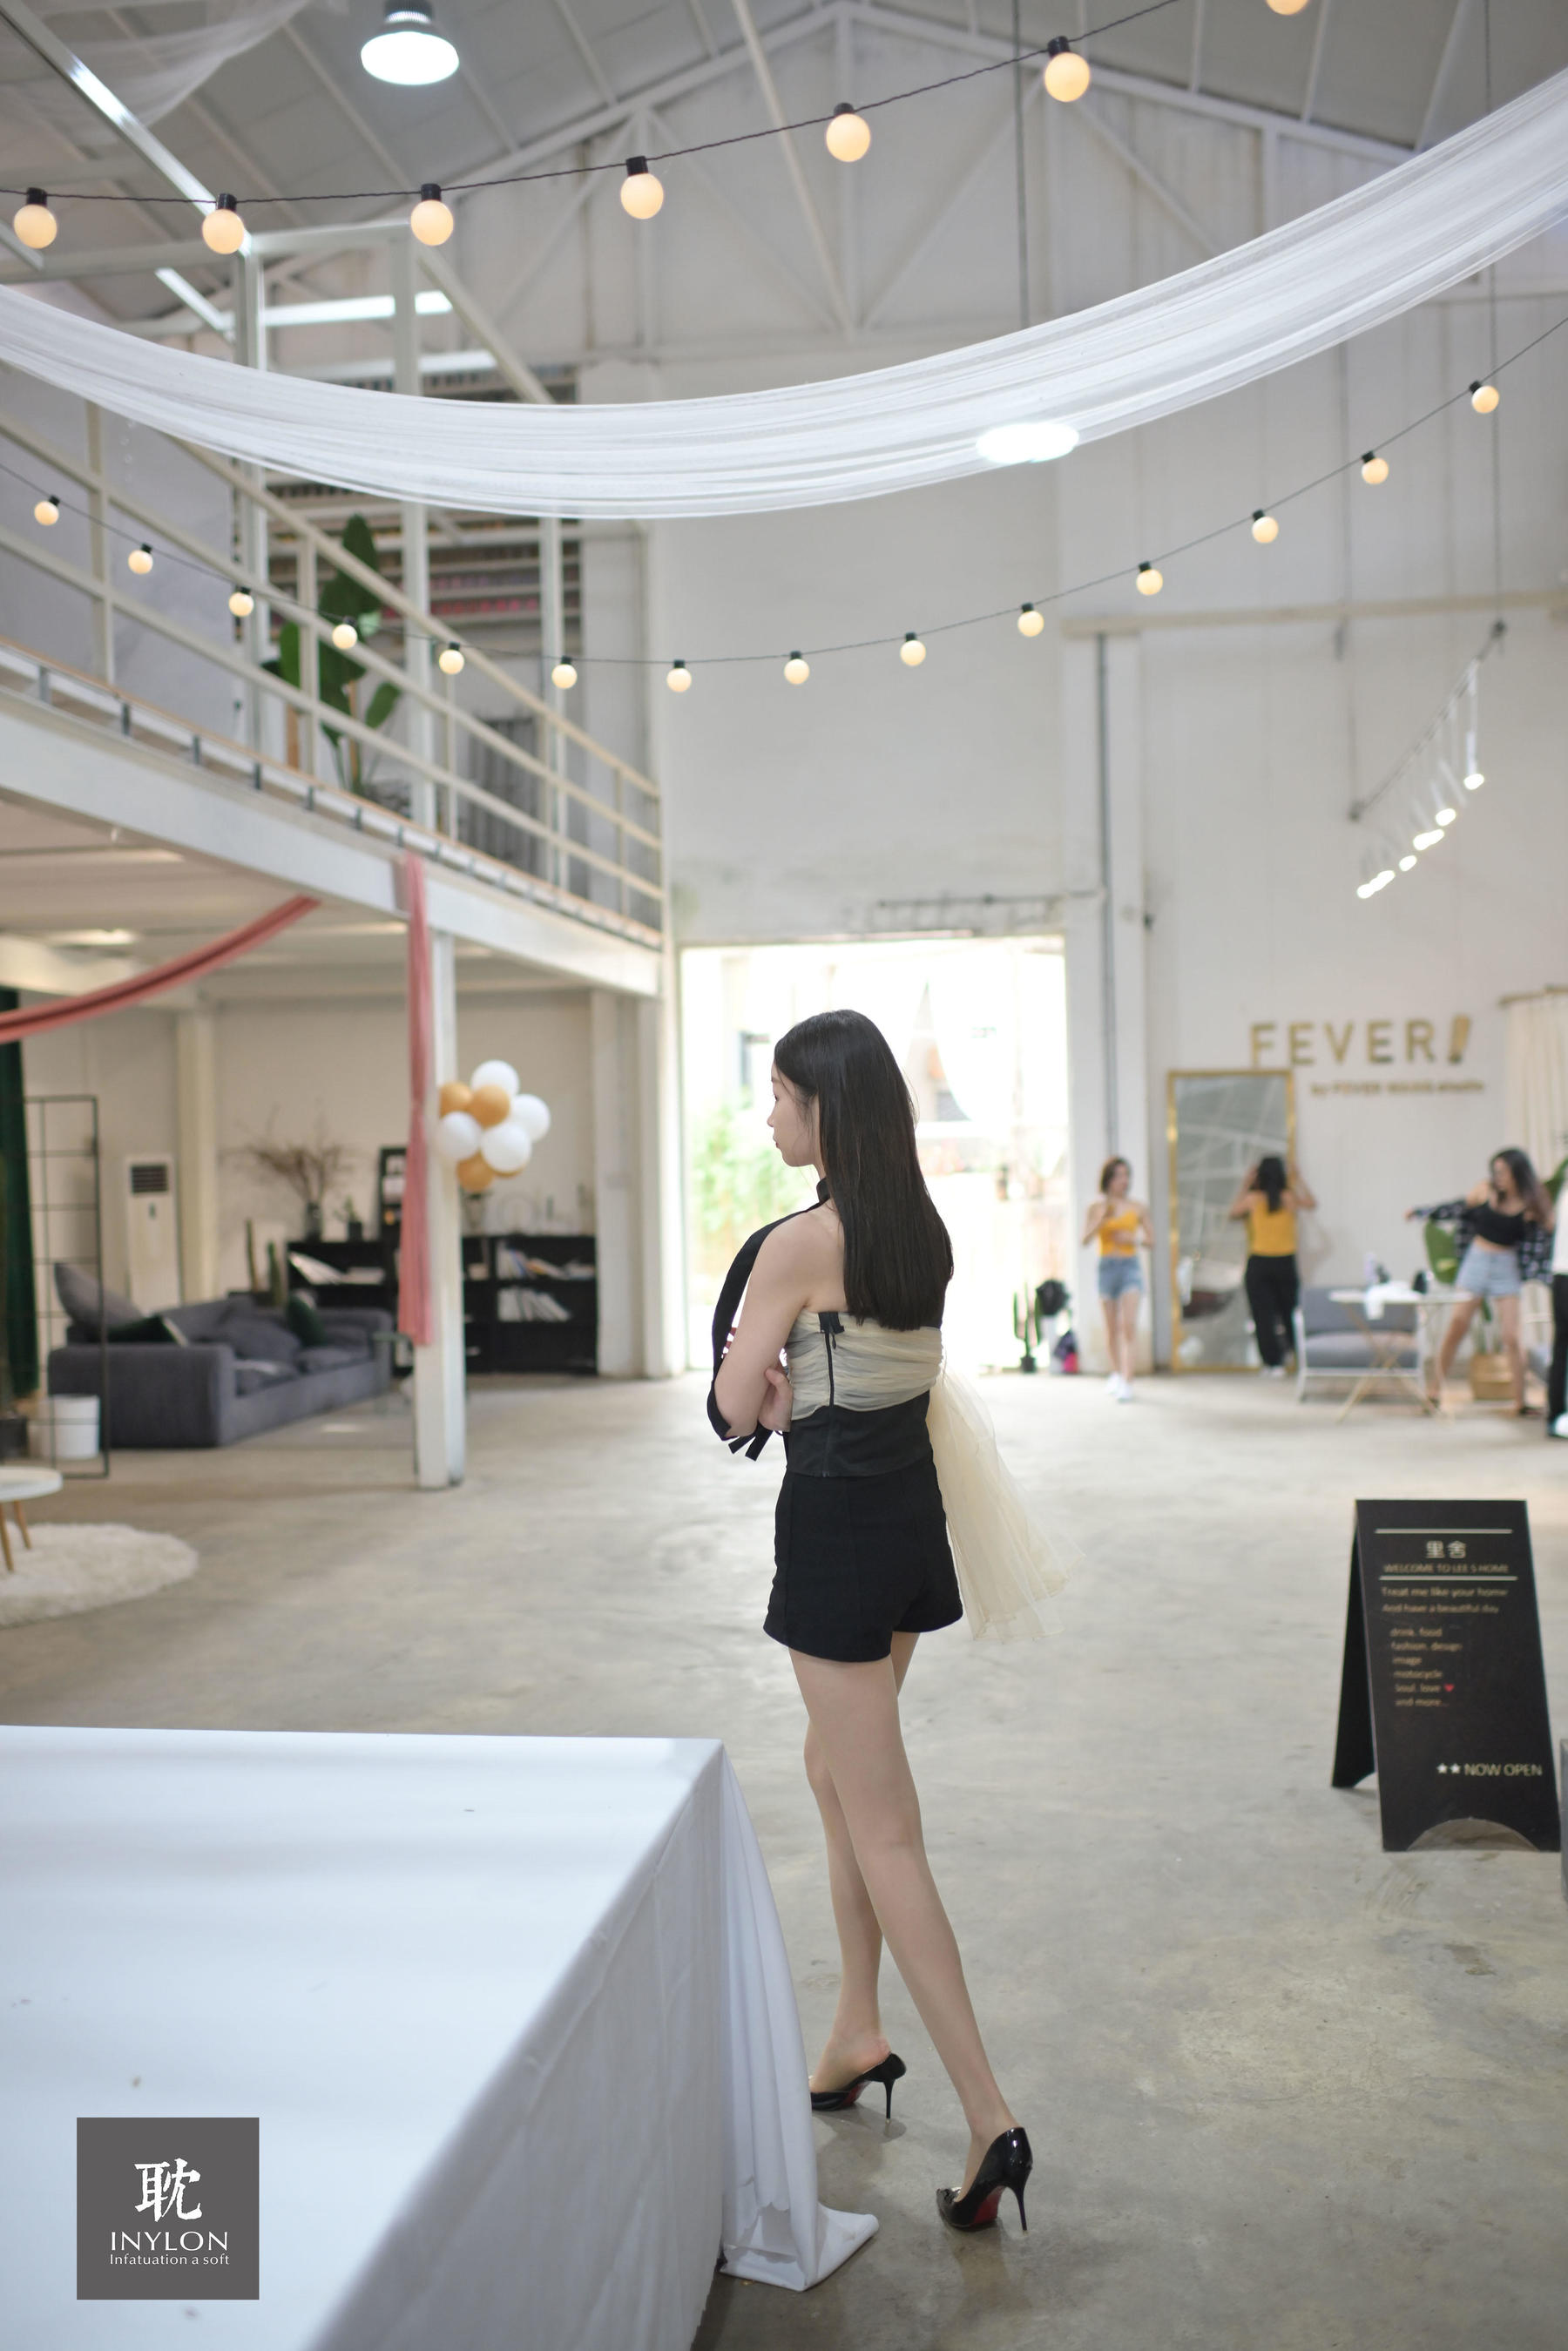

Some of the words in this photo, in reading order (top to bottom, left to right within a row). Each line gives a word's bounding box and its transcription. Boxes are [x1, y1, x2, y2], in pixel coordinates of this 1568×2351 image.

[1249, 1014, 1471, 1067] FEVER!
[1383, 1563, 1434, 1573] WELCOME
[1437, 1563, 1450, 1573] TO
[1478, 1563, 1509, 1573] HOME
[1381, 1586, 1409, 1597] Treat
[1410, 1588, 1429, 1597] me
[1430, 1586, 1450, 1597] like
[1451, 1588, 1475, 1598] your
[1477, 1586, 1509, 1597] home
[1419, 1626, 1443, 1637] food
[1420, 1683, 1442, 1692] love
[1395, 1697, 1414, 1706] and
[1464, 1763, 1502, 1776] NOW
[1504, 1763, 1543, 1776] OPEN
